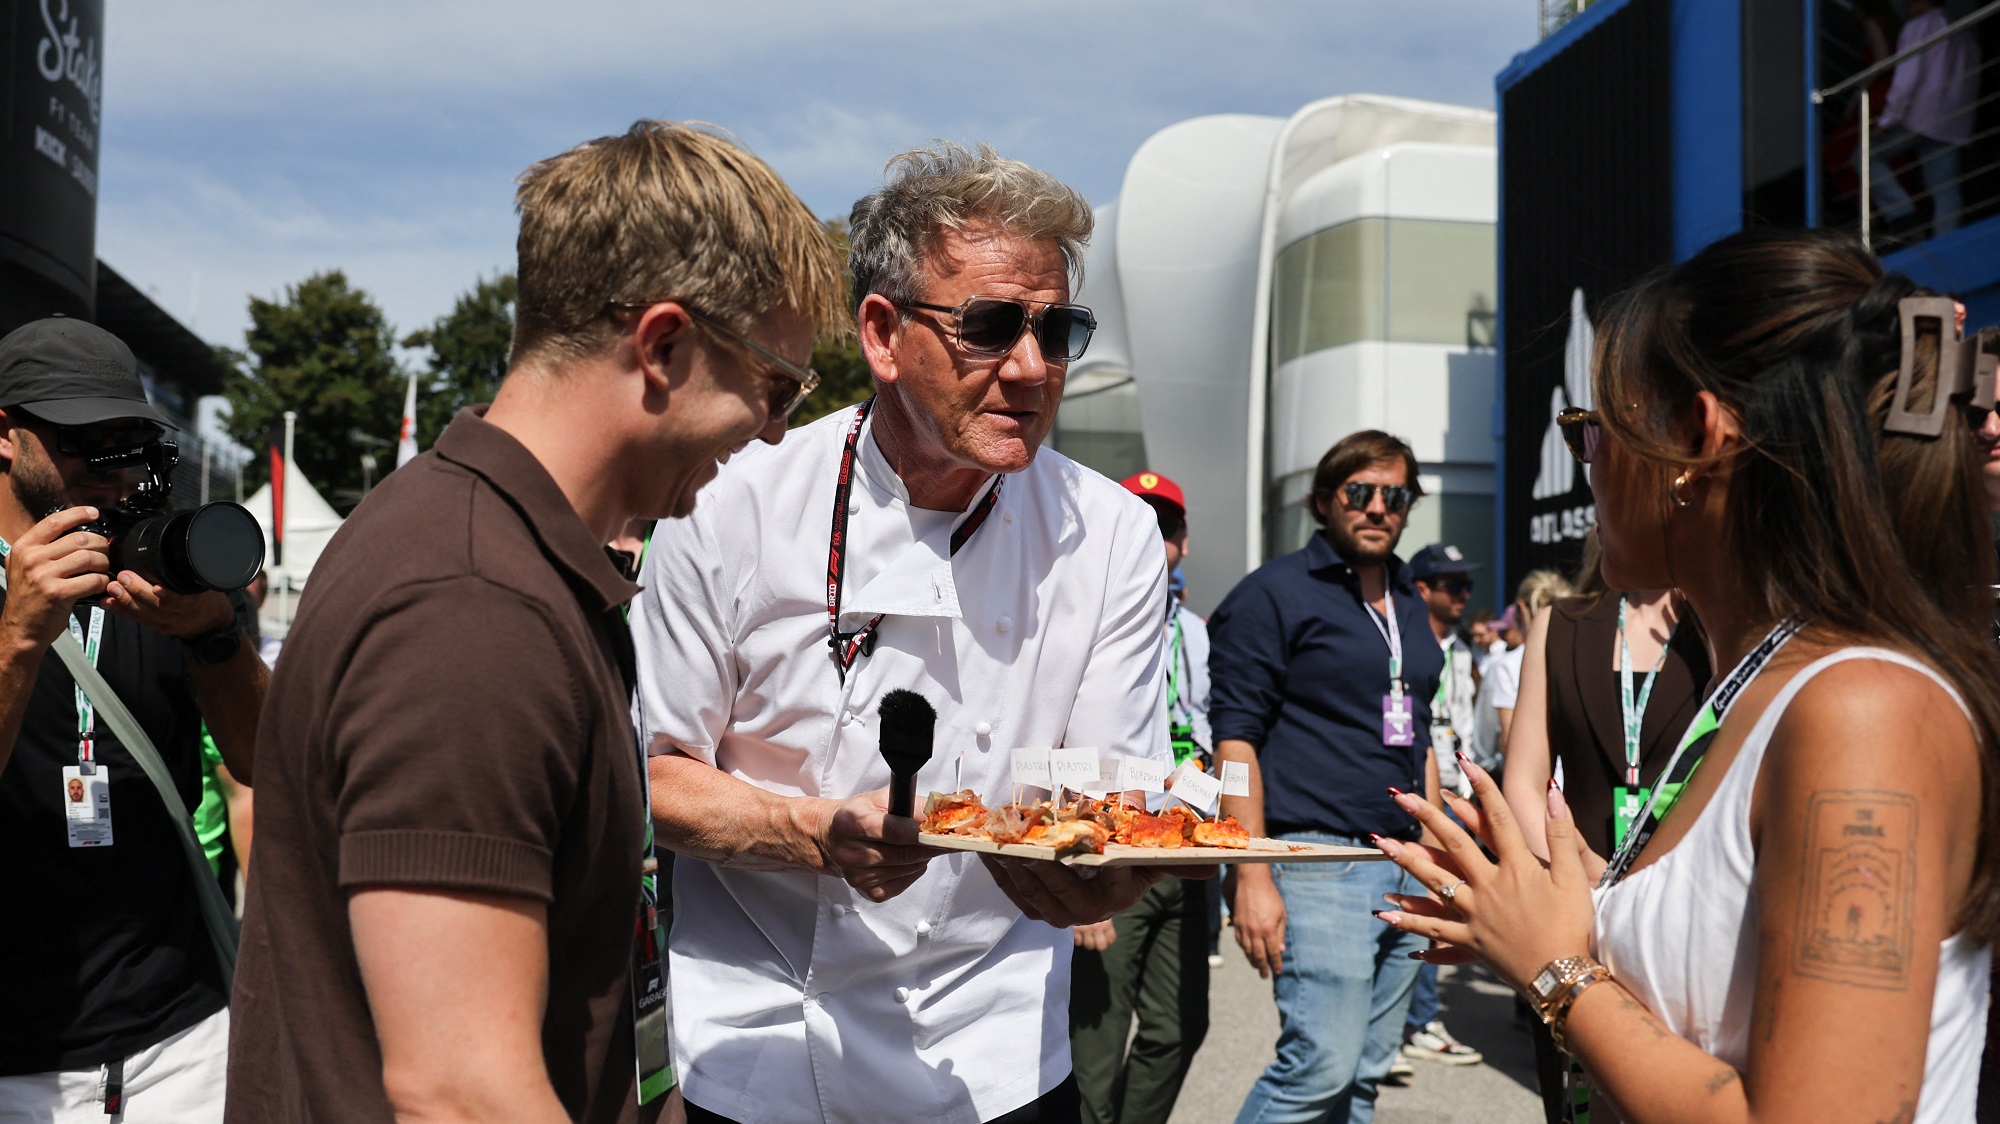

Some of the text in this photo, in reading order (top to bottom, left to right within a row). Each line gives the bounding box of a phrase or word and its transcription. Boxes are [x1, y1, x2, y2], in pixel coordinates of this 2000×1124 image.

[839, 450, 852, 484] 2025
[90, 609, 101, 635] ITALY
[1015, 760, 1047, 772] PIASTRI
[1056, 760, 1093, 772] PIASTRI
[1130, 766, 1163, 785] BEARMAN
[1182, 775, 1215, 800] BEARMAN
[638, 986, 668, 1009] GARAGE
